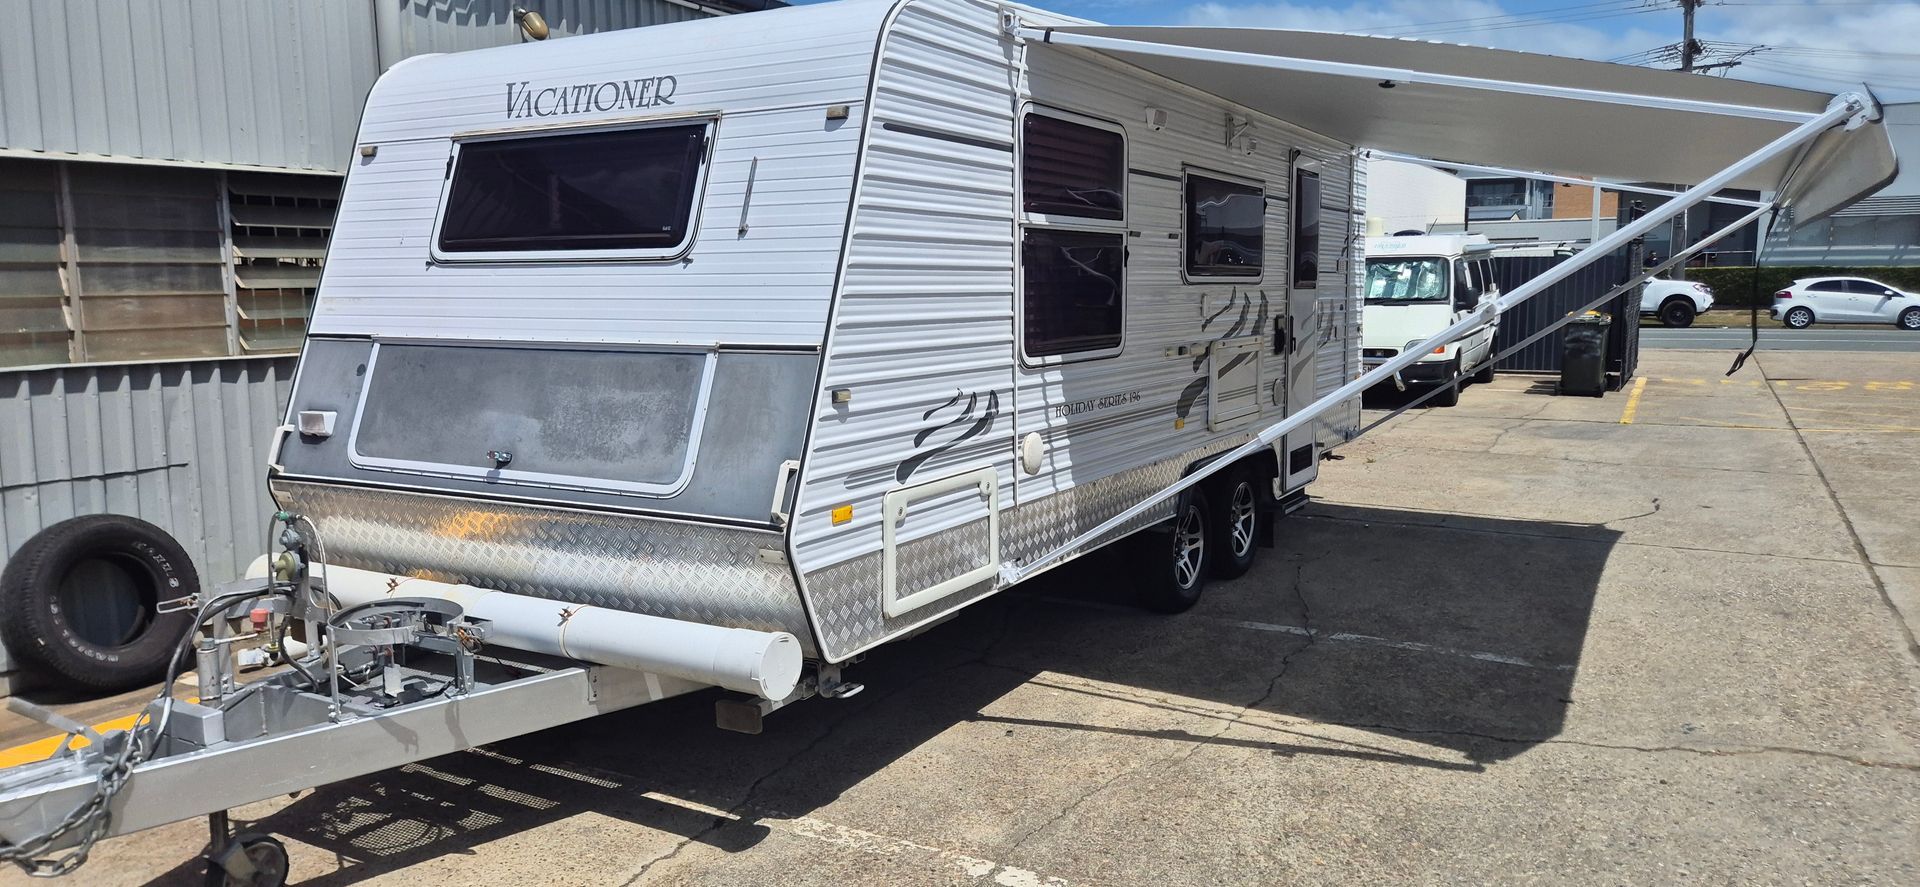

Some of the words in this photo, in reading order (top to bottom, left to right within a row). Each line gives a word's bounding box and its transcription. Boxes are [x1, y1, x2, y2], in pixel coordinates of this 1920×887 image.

[506, 75, 678, 119] VACATIONER
[1055, 400, 1095, 418] HOLIDAY
[1097, 393, 1127, 410] SERIES
[1129, 391, 1141, 403] 196
